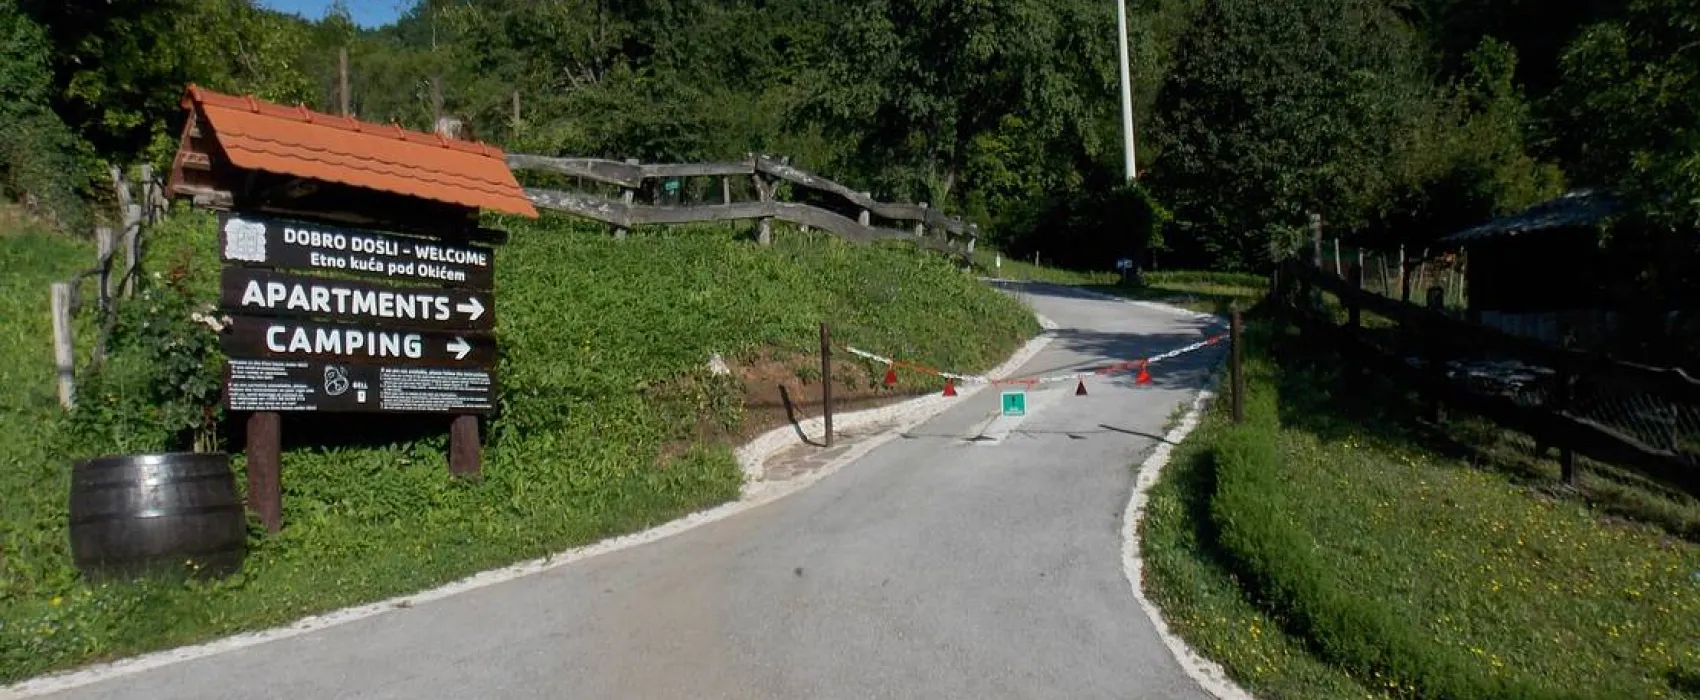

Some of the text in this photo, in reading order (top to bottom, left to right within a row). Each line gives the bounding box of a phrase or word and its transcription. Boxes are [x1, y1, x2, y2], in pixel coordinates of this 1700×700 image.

[284, 229, 346, 249] DOBRO
[415, 245, 487, 266] WELCOME
[311, 253, 466, 282] Etno kuća pod Okićem
[242, 279, 450, 320] APARTMENTS
[266, 326, 422, 358] CAMPING
